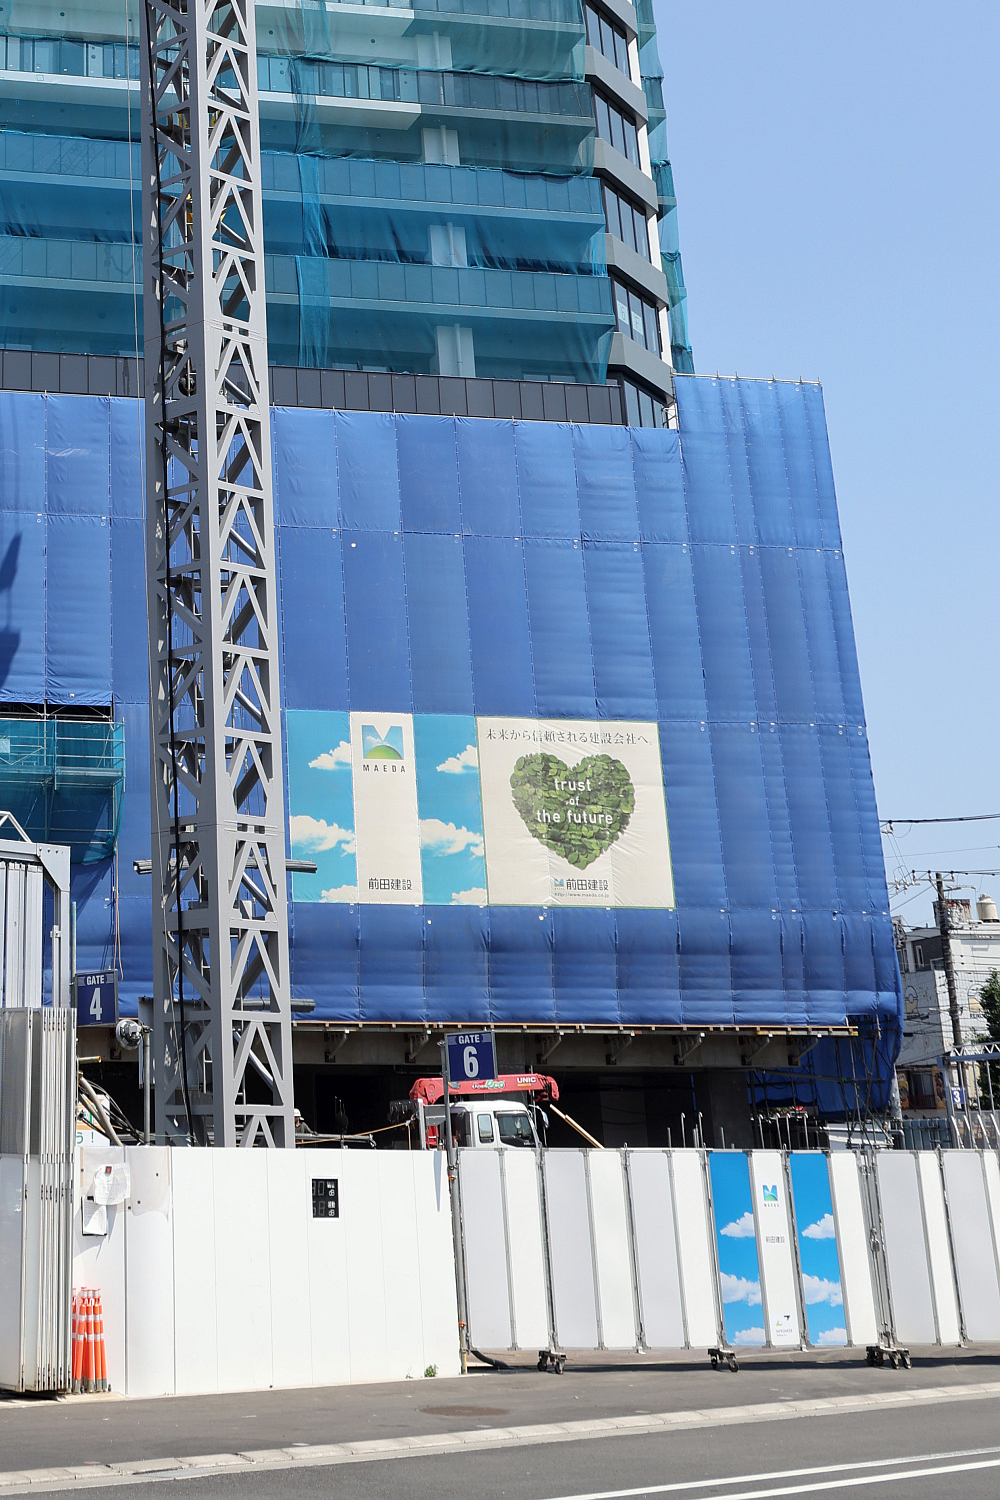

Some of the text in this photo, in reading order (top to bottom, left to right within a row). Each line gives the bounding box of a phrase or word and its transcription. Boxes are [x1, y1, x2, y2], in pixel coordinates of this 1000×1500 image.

[486, 728, 653, 746] 未来から信頼される建設会社へ。
[362, 764, 406, 773] MAEDA
[555, 779, 591, 792] trust
[569, 796, 579, 806] of
[537, 809, 613, 825] the future
[368, 878, 413, 891] 前田建設
[566, 879, 609, 891] 前田建設
[86, 975, 105, 986] GATE
[90, 987, 103, 1021] 4
[458, 1034, 480, 1045] GATE
[463, 1045, 479, 1078] 6
[517, 1076, 537, 1084] UNIC
[953, 1091, 961, 1103] 3
